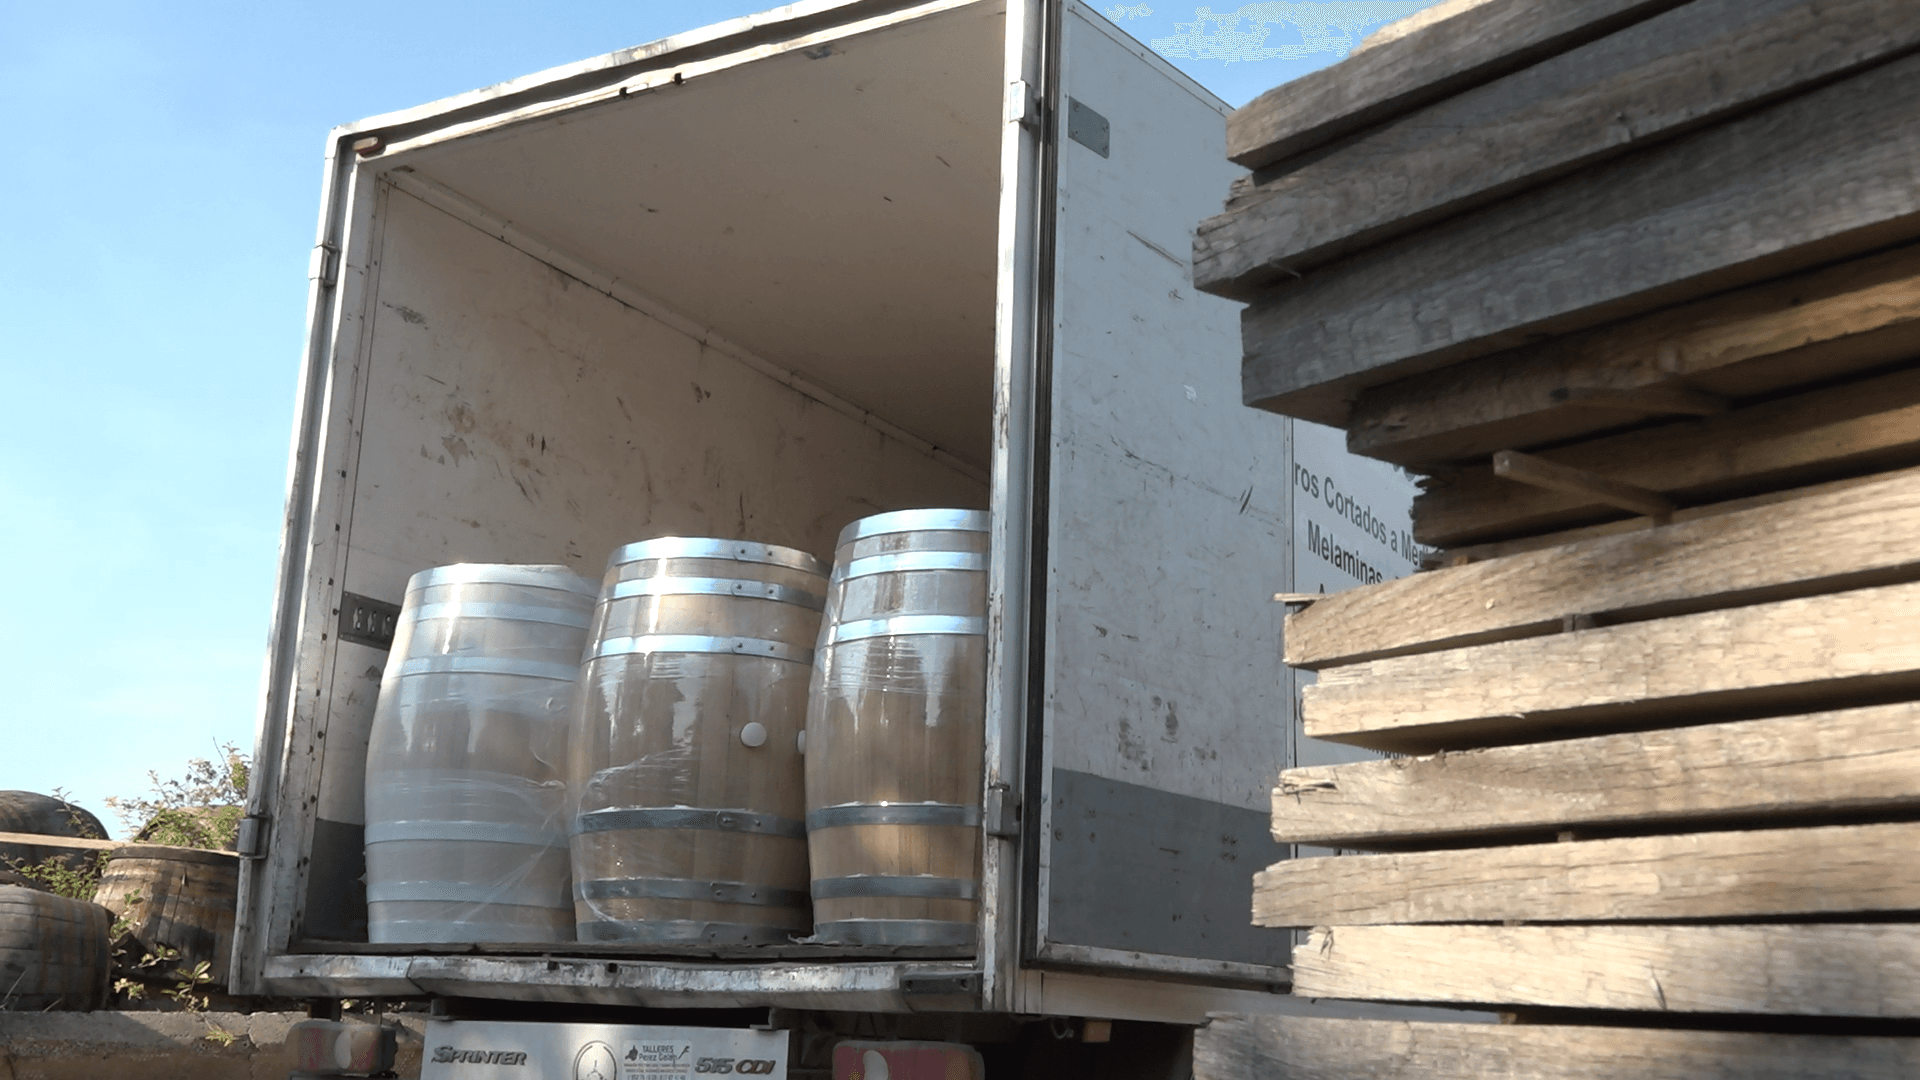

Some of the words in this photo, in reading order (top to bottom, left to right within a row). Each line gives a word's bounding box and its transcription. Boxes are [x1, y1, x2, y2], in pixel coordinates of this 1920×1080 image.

[1324, 476, 1387, 545] Cortados
[1391, 530, 1398, 553] a
[694, 1057, 735, 1074] 515
[735, 1059, 776, 1075] CDI
